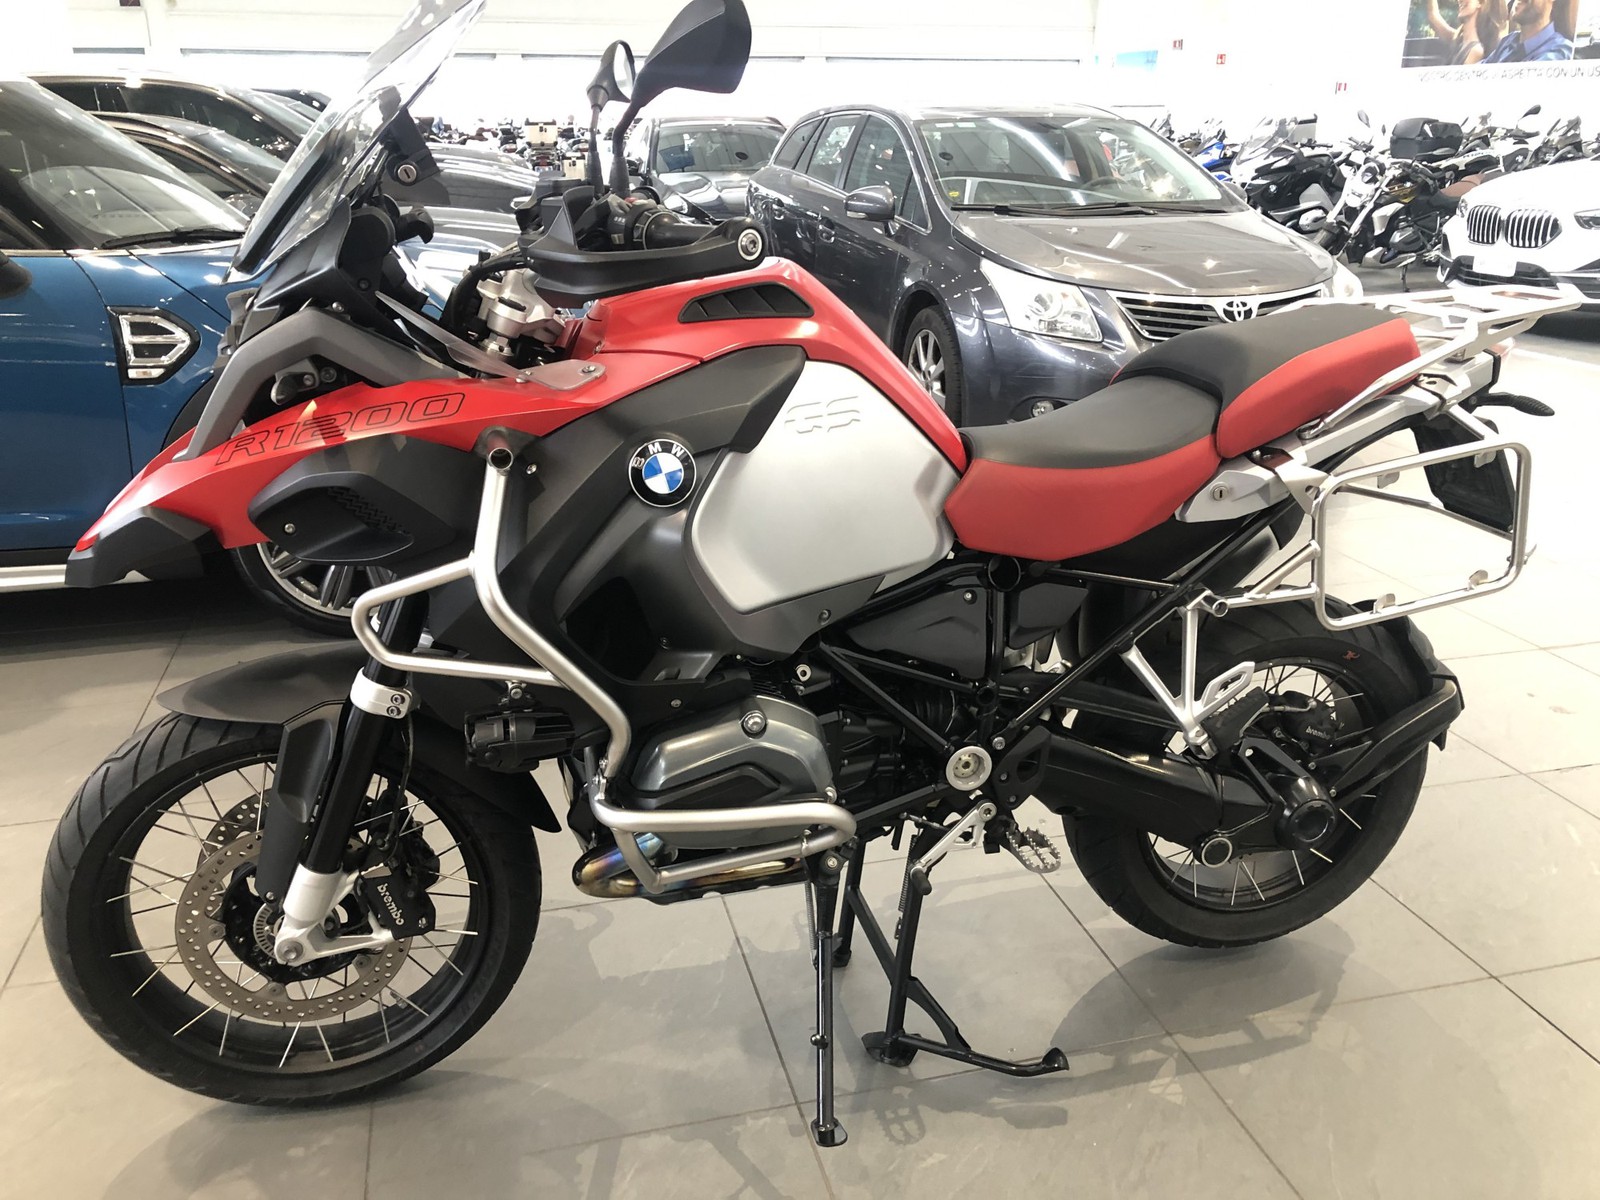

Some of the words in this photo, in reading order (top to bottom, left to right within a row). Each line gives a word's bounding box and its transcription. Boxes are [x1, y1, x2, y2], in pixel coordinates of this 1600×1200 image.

[1546, 65, 1567, 78] CON
[1570, 65, 1585, 78] UN
[215, 393, 460, 467] R1200
[784, 395, 861, 434] GS
[631, 443, 685, 470] BMW
[376, 882, 405, 926] brembo
